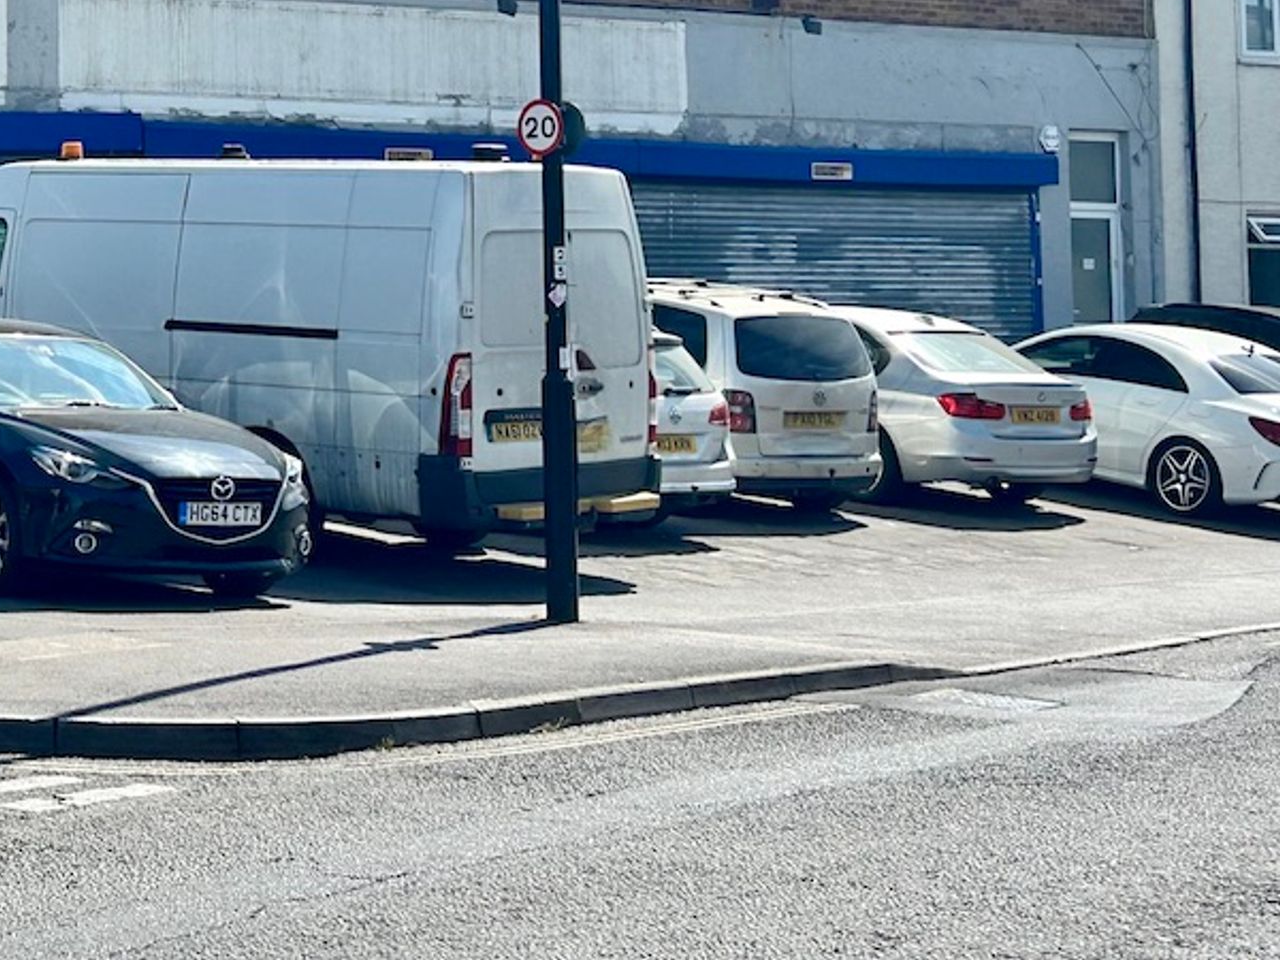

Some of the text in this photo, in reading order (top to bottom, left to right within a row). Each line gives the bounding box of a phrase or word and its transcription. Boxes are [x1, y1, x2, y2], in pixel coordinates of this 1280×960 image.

[525, 115, 556, 139] 20
[190, 504, 260, 522] HG64 CTX
